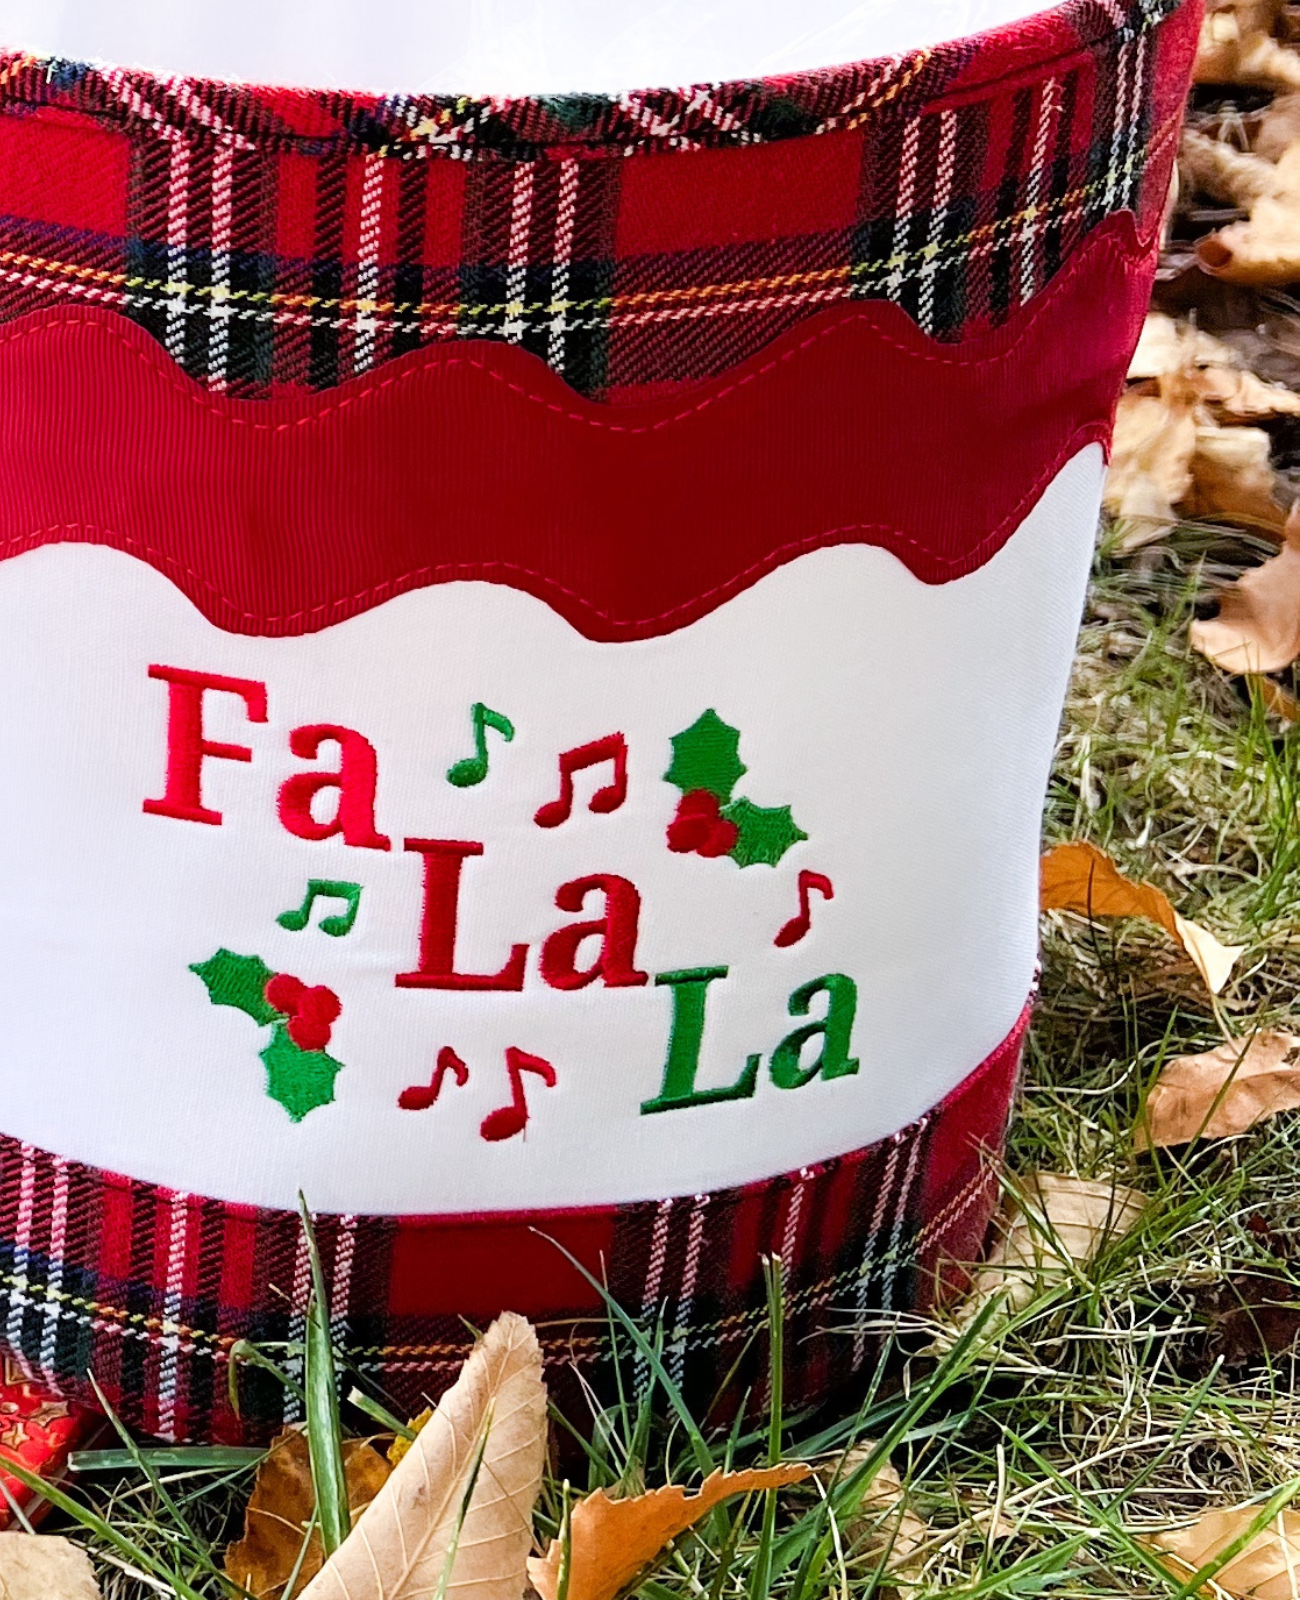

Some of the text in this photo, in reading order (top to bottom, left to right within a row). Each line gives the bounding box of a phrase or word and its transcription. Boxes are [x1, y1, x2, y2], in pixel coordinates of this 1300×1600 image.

[142, 663, 391, 852] Fa
[394, 837, 649, 992] La
[639, 965, 860, 1116] La
